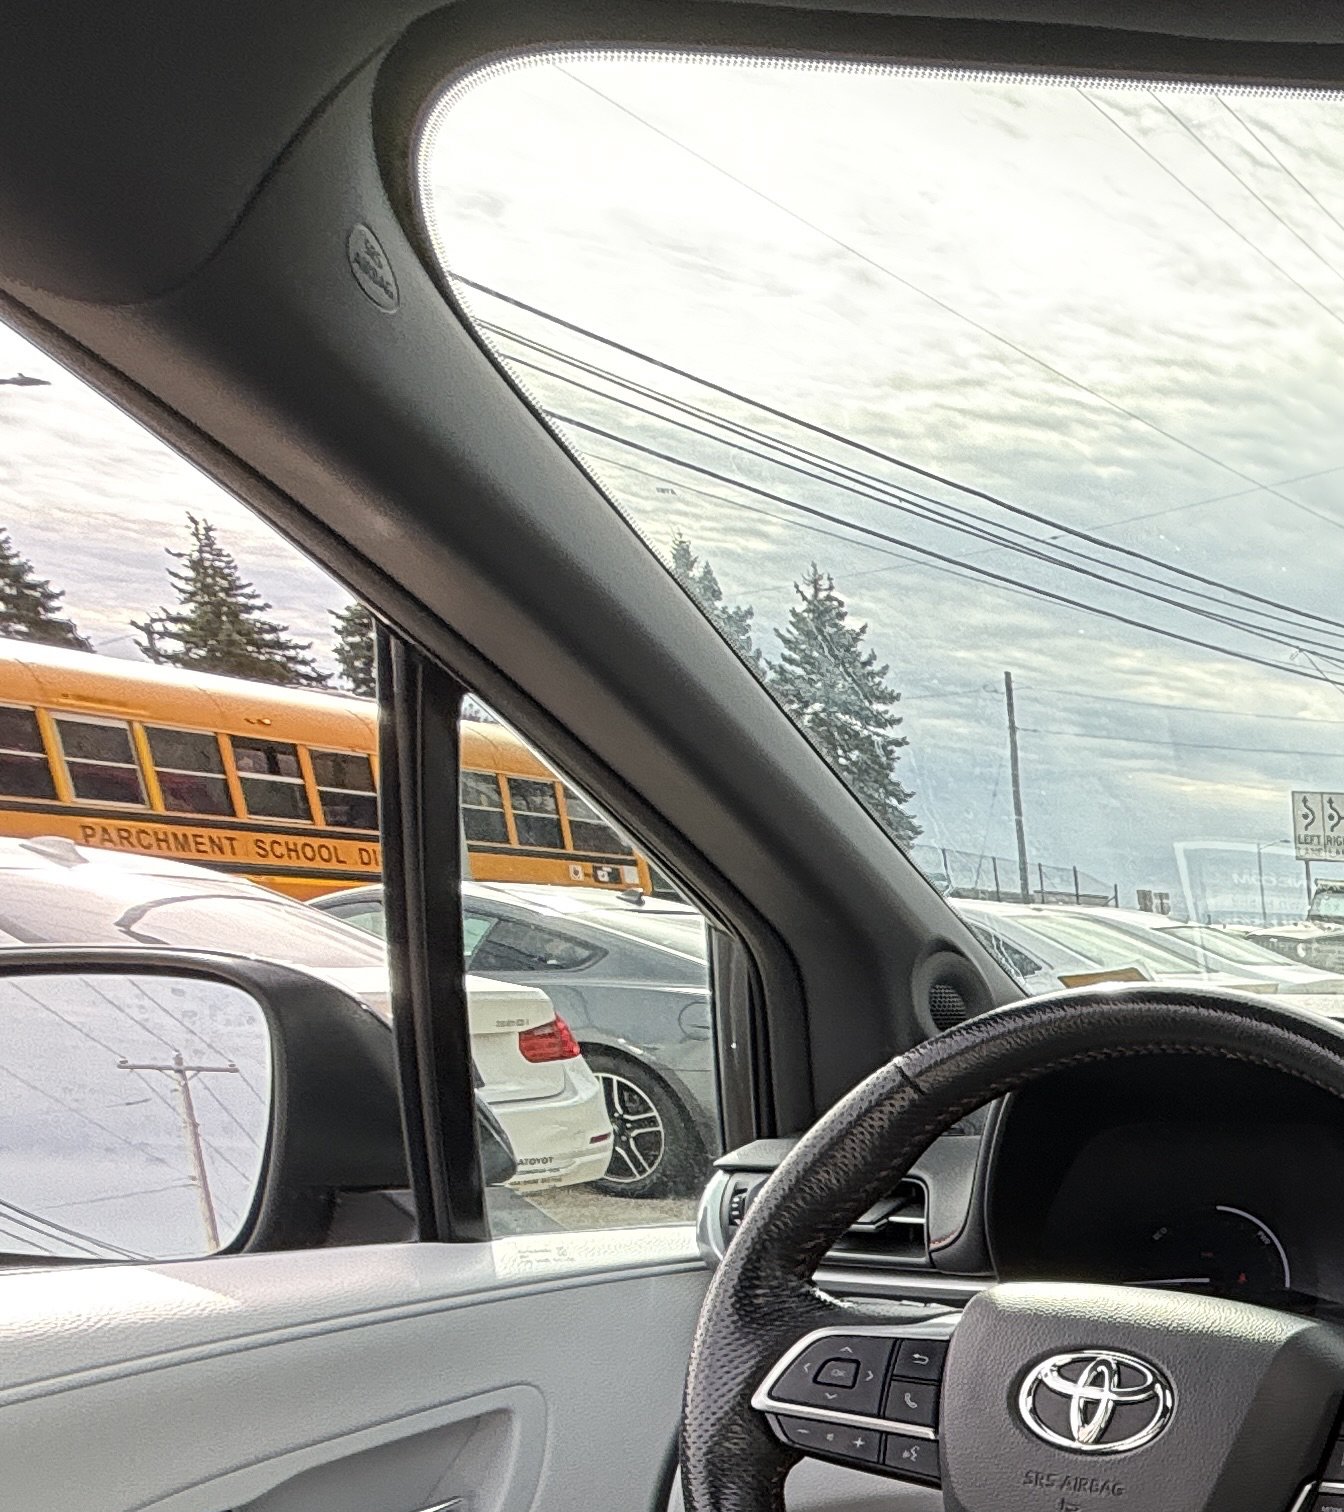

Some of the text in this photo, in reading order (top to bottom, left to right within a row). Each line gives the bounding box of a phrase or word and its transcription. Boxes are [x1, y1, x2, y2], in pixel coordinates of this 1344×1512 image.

[81, 824, 237, 859] PARCHMENT
[255, 838, 347, 867] SCHOOL
[1297, 833, 1322, 845] LEFT
[1023, 1469, 1125, 1497] SRS AIRBAG
